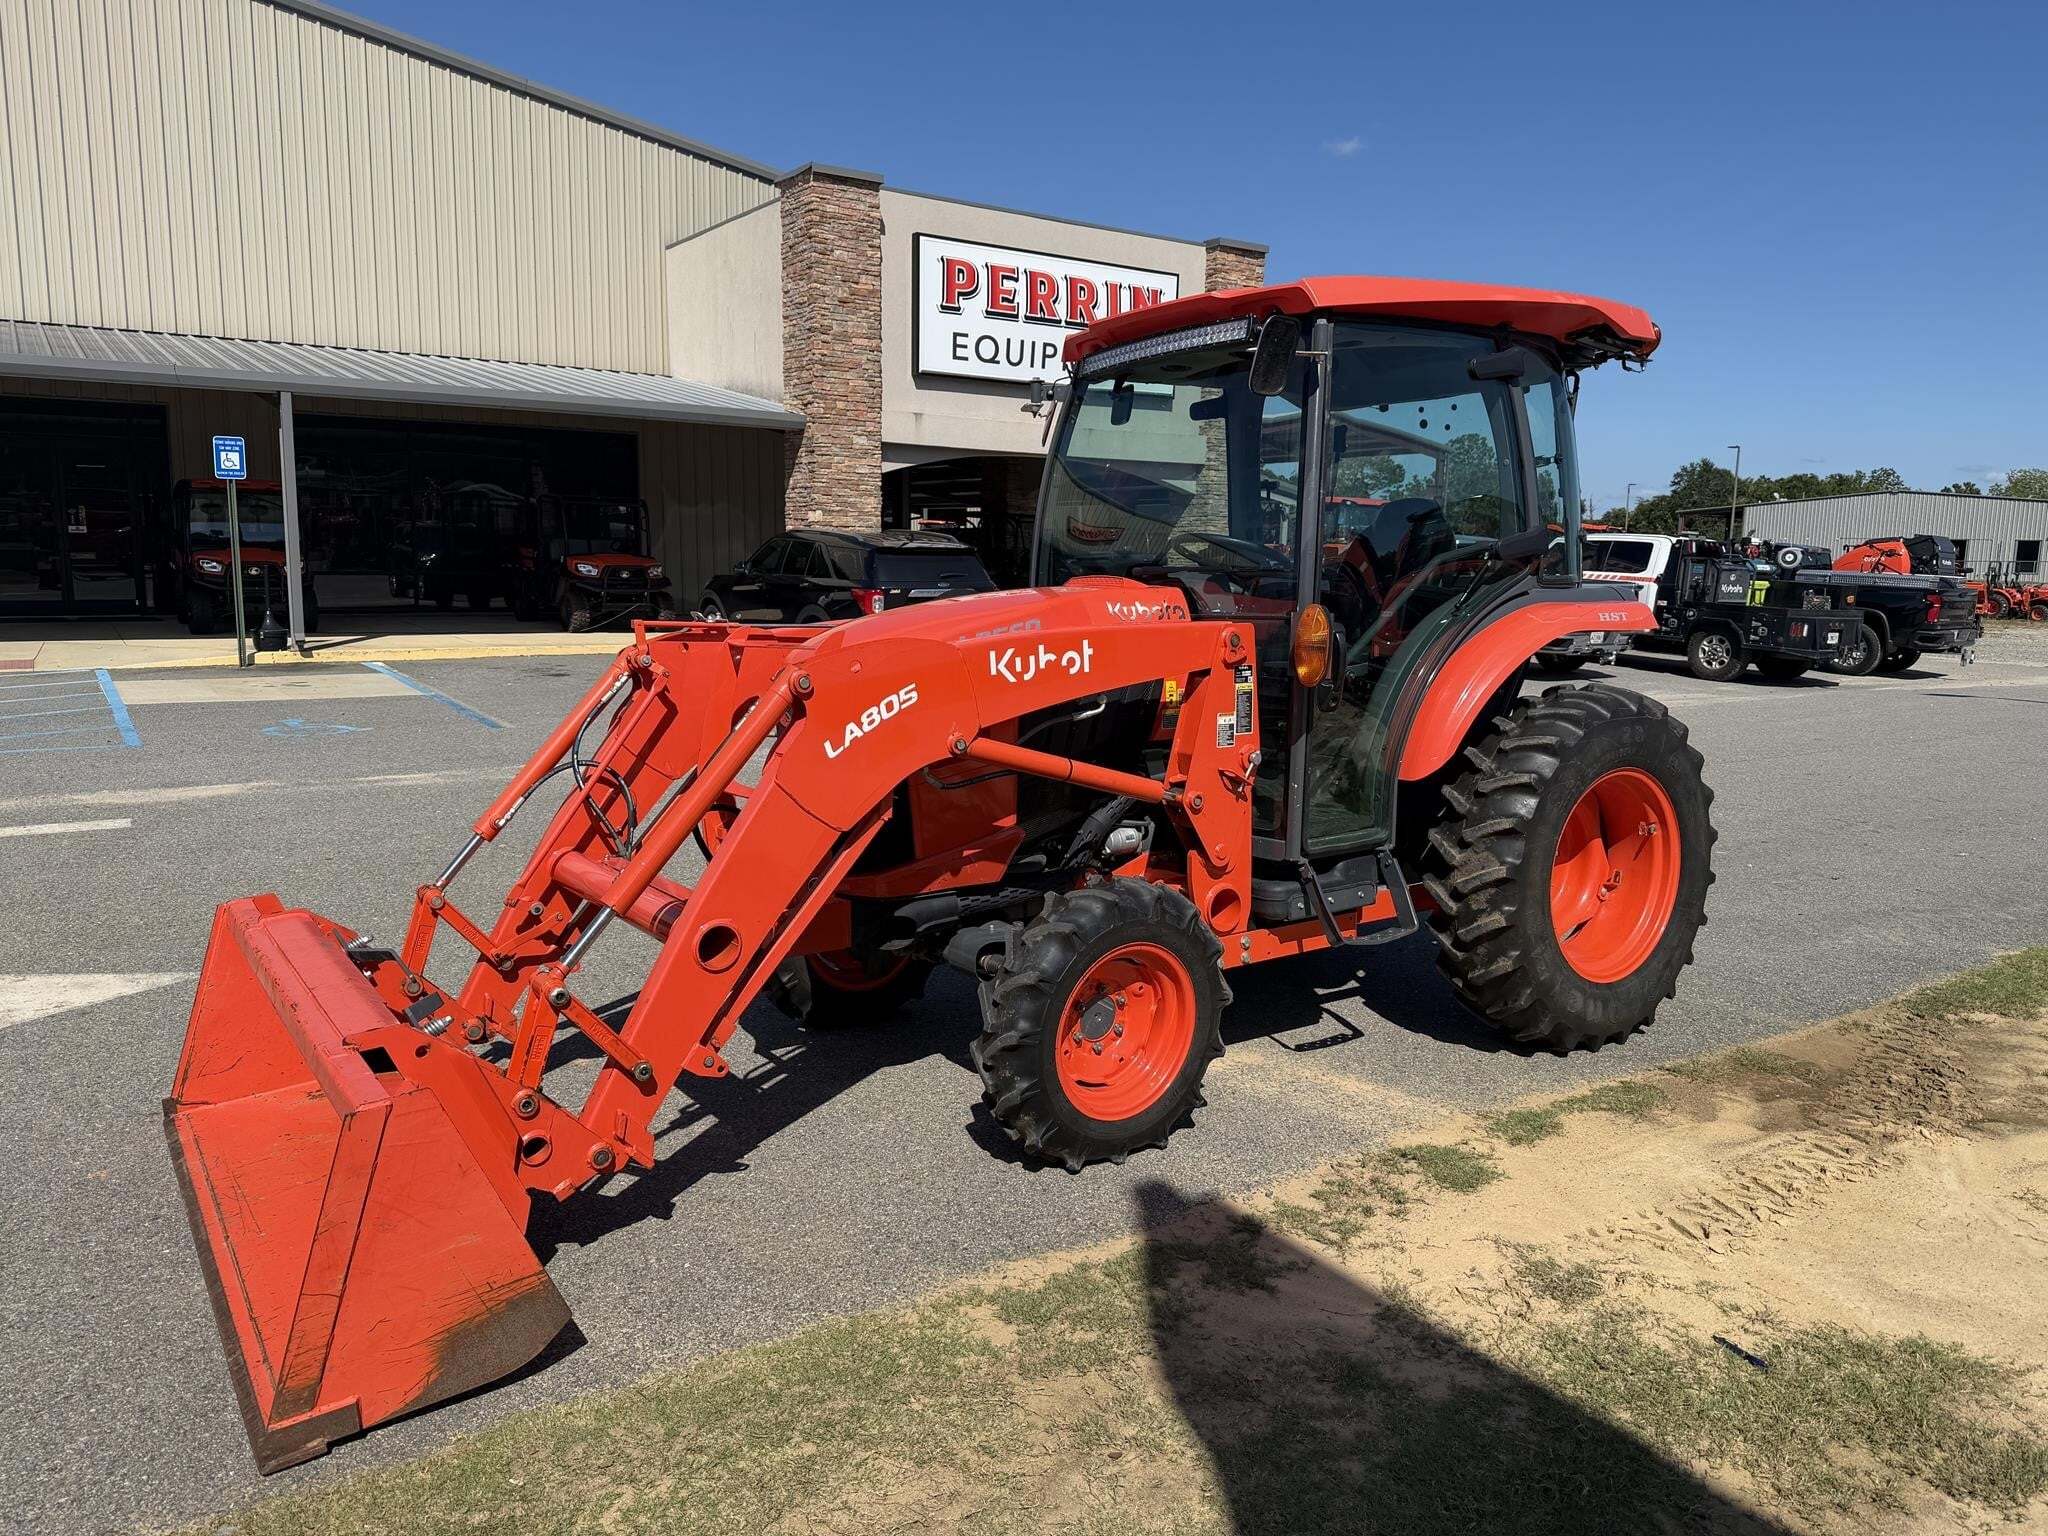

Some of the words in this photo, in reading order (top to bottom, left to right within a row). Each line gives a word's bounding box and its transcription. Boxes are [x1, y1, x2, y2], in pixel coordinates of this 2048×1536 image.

[952, 331, 1065, 371] EQUIP
[1599, 611, 1629, 622] HST
[823, 682, 919, 759] LA805
